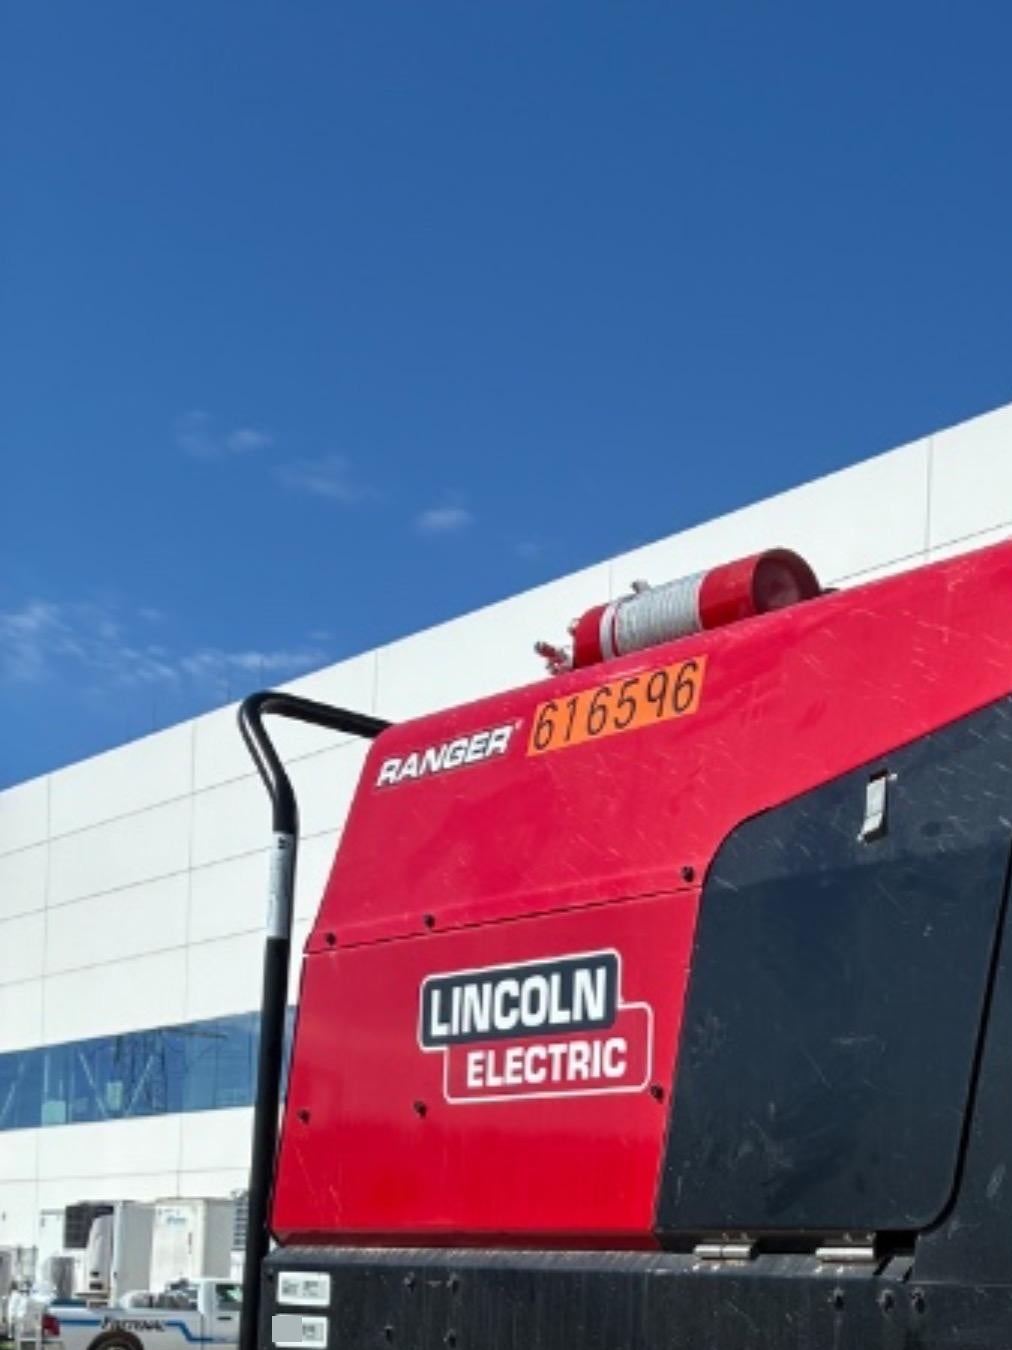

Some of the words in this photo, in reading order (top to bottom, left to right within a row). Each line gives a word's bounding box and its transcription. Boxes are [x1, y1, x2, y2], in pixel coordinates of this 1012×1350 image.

[533, 660, 700, 751] 616596
[376, 725, 514, 787] RANGER
[430, 967, 607, 1037] LINCOLN
[466, 1038, 628, 1089] ELECTRIC
